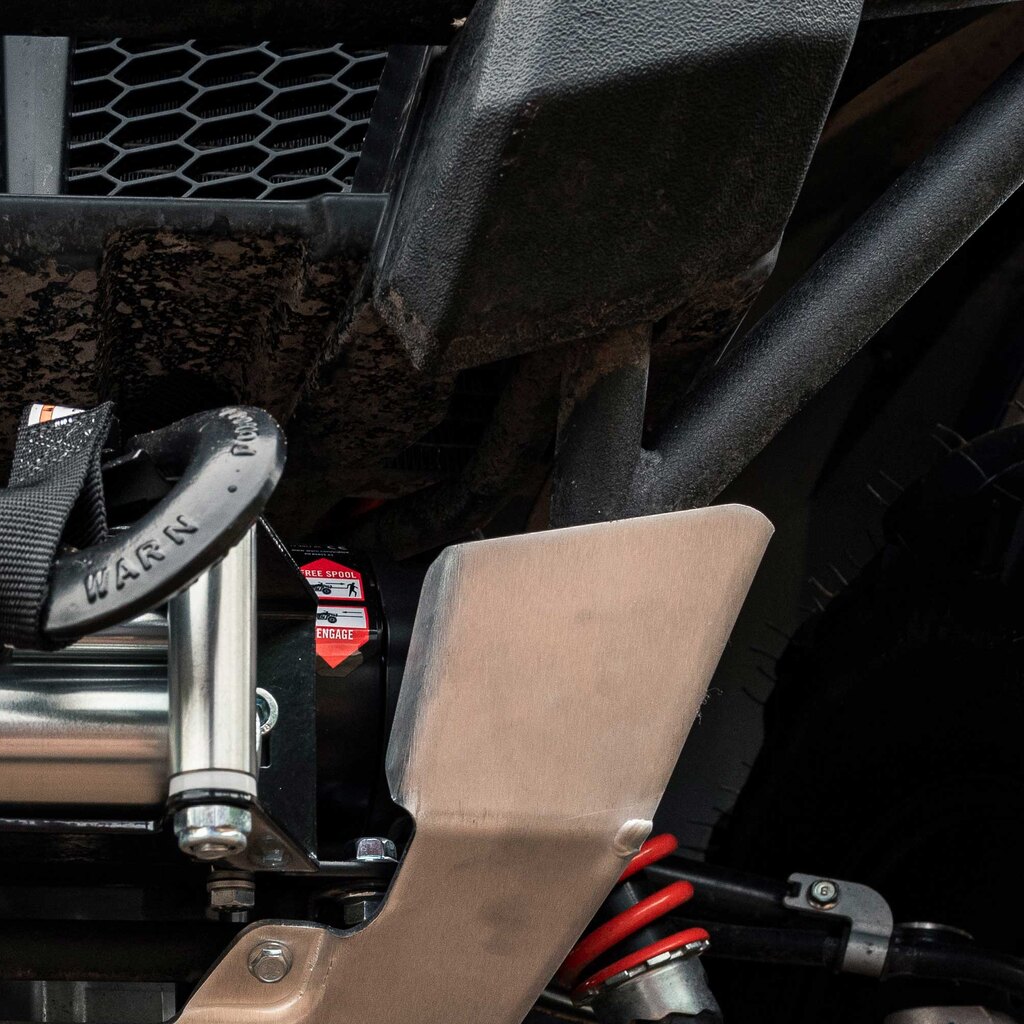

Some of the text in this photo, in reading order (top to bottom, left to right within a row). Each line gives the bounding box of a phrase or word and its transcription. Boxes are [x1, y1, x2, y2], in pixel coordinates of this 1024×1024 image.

[83, 514, 199, 605] WARN
[326, 570, 357, 579] SPOOL
[316, 628, 353, 640] ENGAGE
